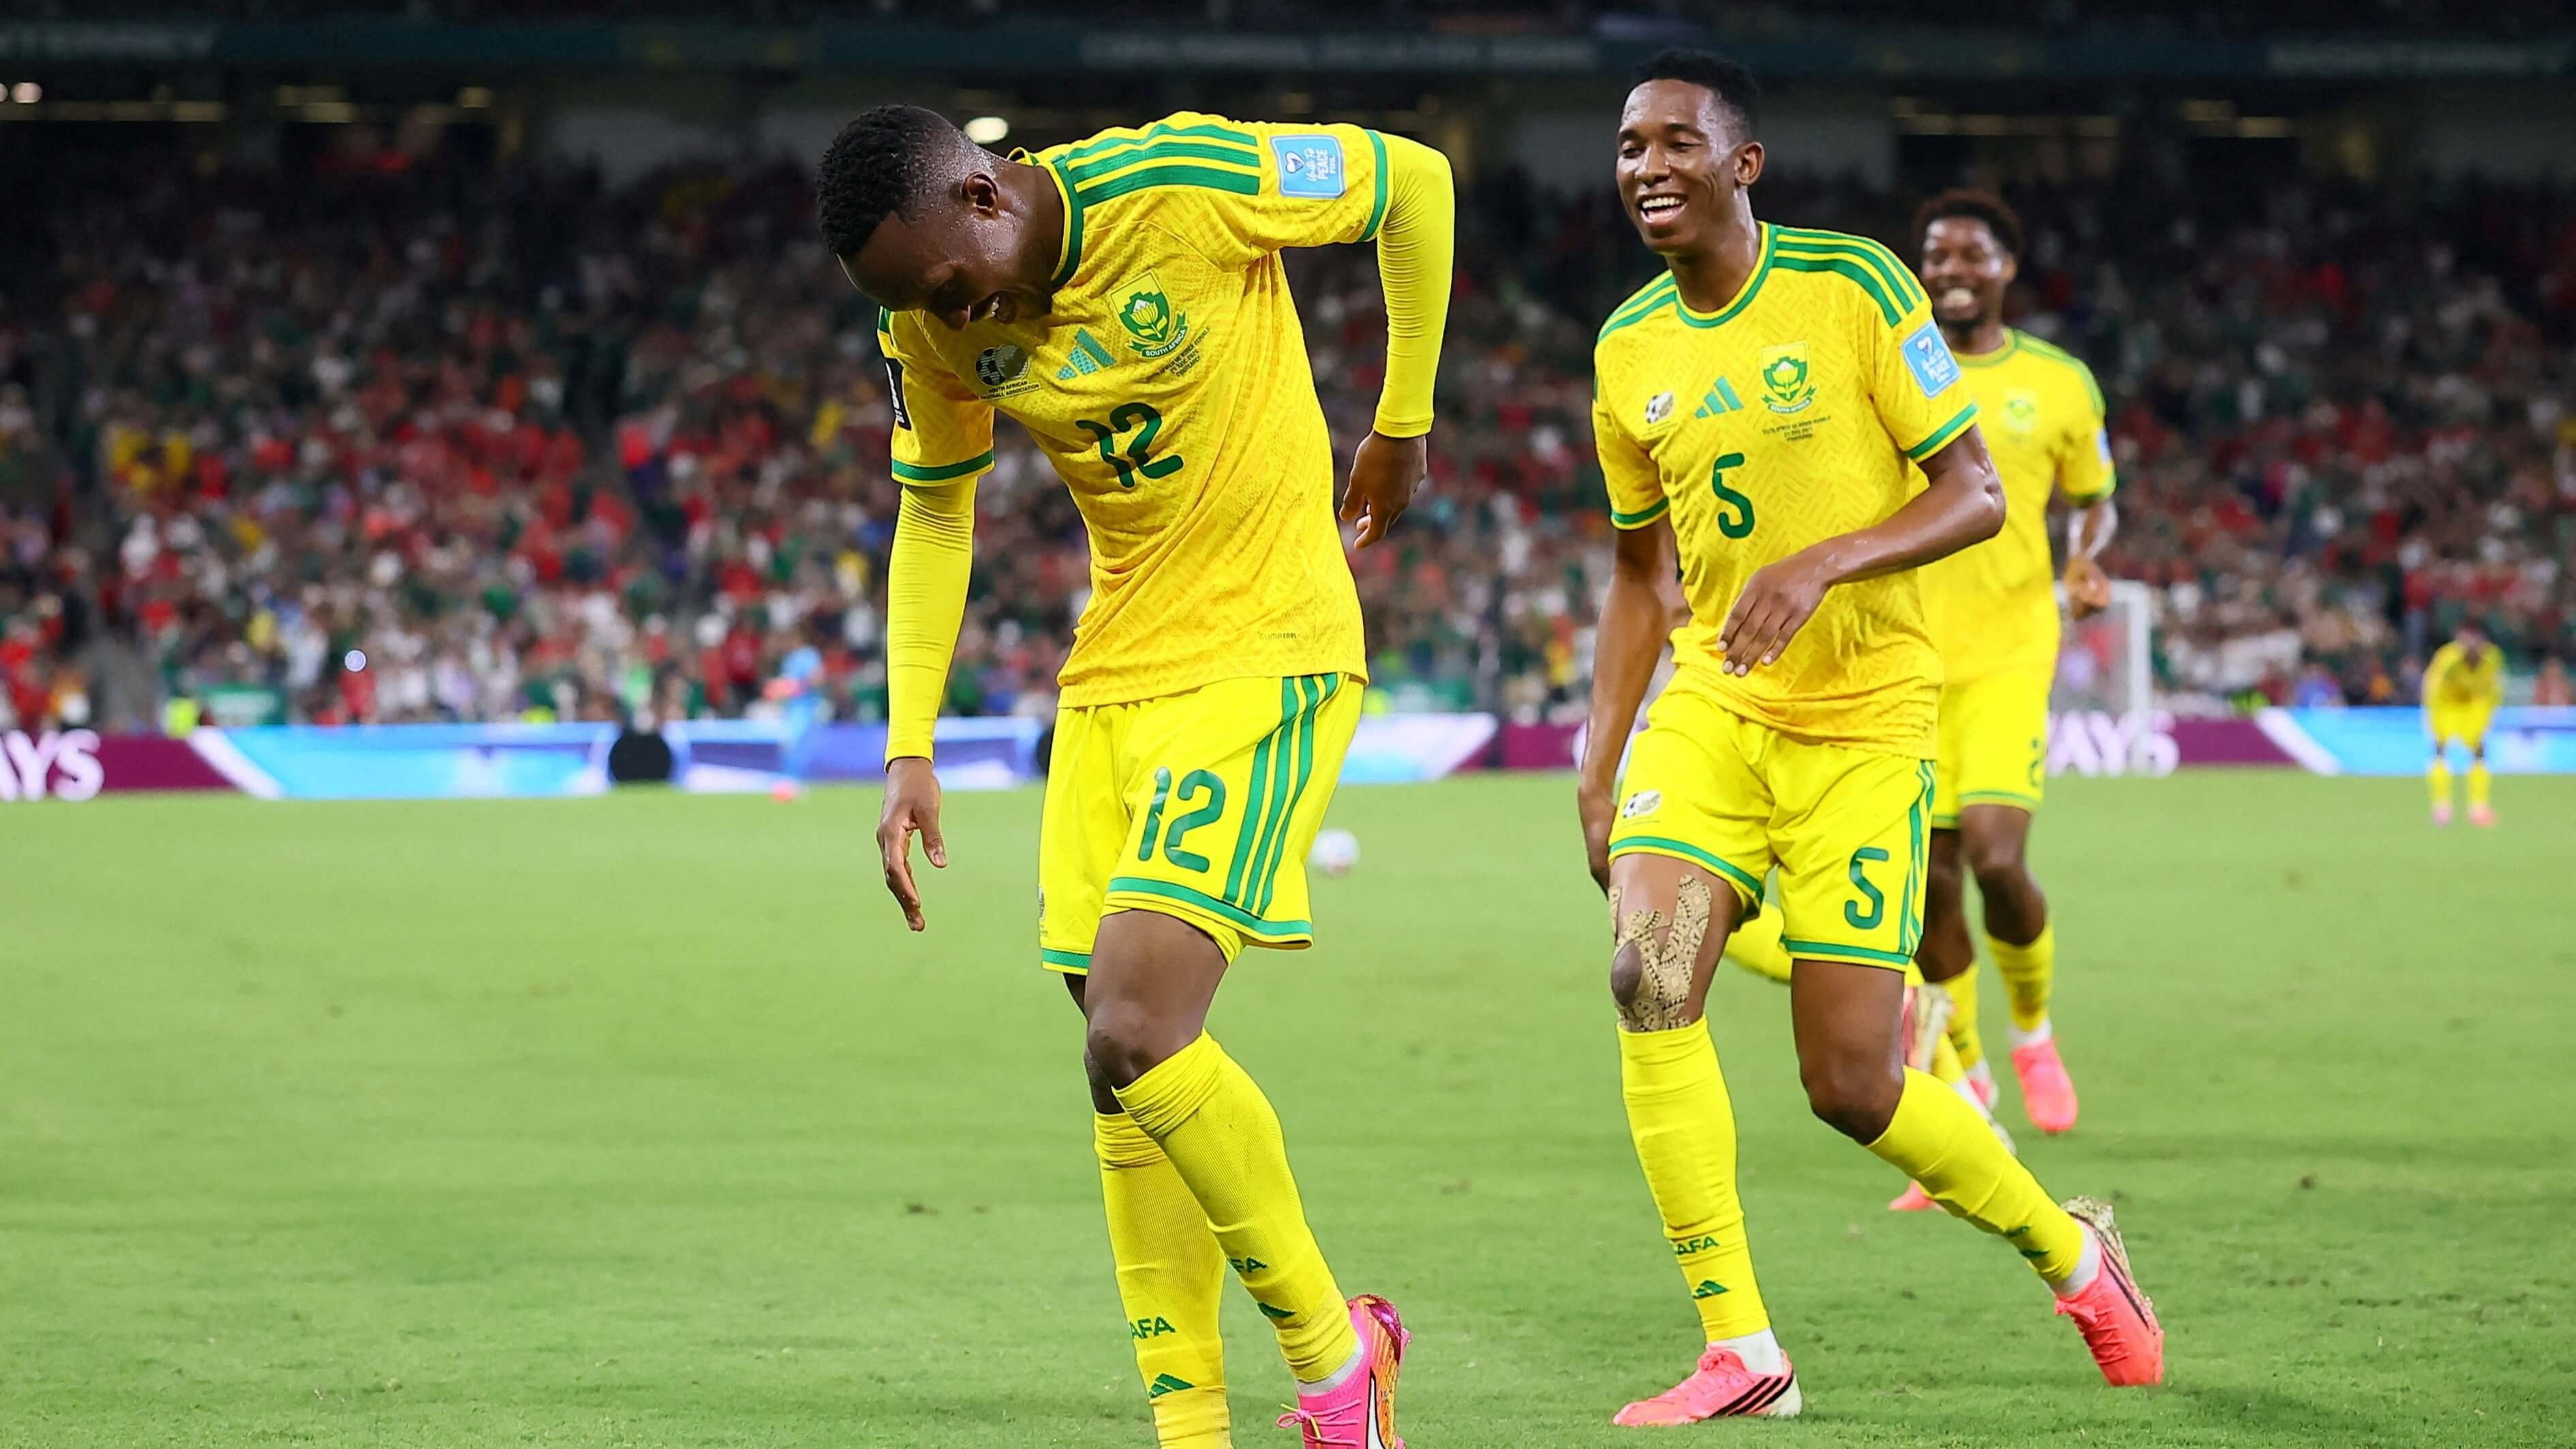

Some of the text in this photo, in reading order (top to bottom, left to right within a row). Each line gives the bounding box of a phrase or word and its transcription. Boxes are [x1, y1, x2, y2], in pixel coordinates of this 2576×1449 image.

[1316, 149, 1329, 180] PEACE
[1145, 329, 1186, 356] SOUTH AFRICA
[1006, 381, 1028, 389] AFRICAN
[1006, 384, 1039, 395] ASSOCIATION
[1075, 402, 1184, 488] 12
[1712, 452, 1755, 539] 5
[2046, 709, 2180, 778] AYS
[1137, 766, 1226, 874] 12
[1844, 846, 1890, 930] 5
[1129, 1316, 1176, 1339] AFA
